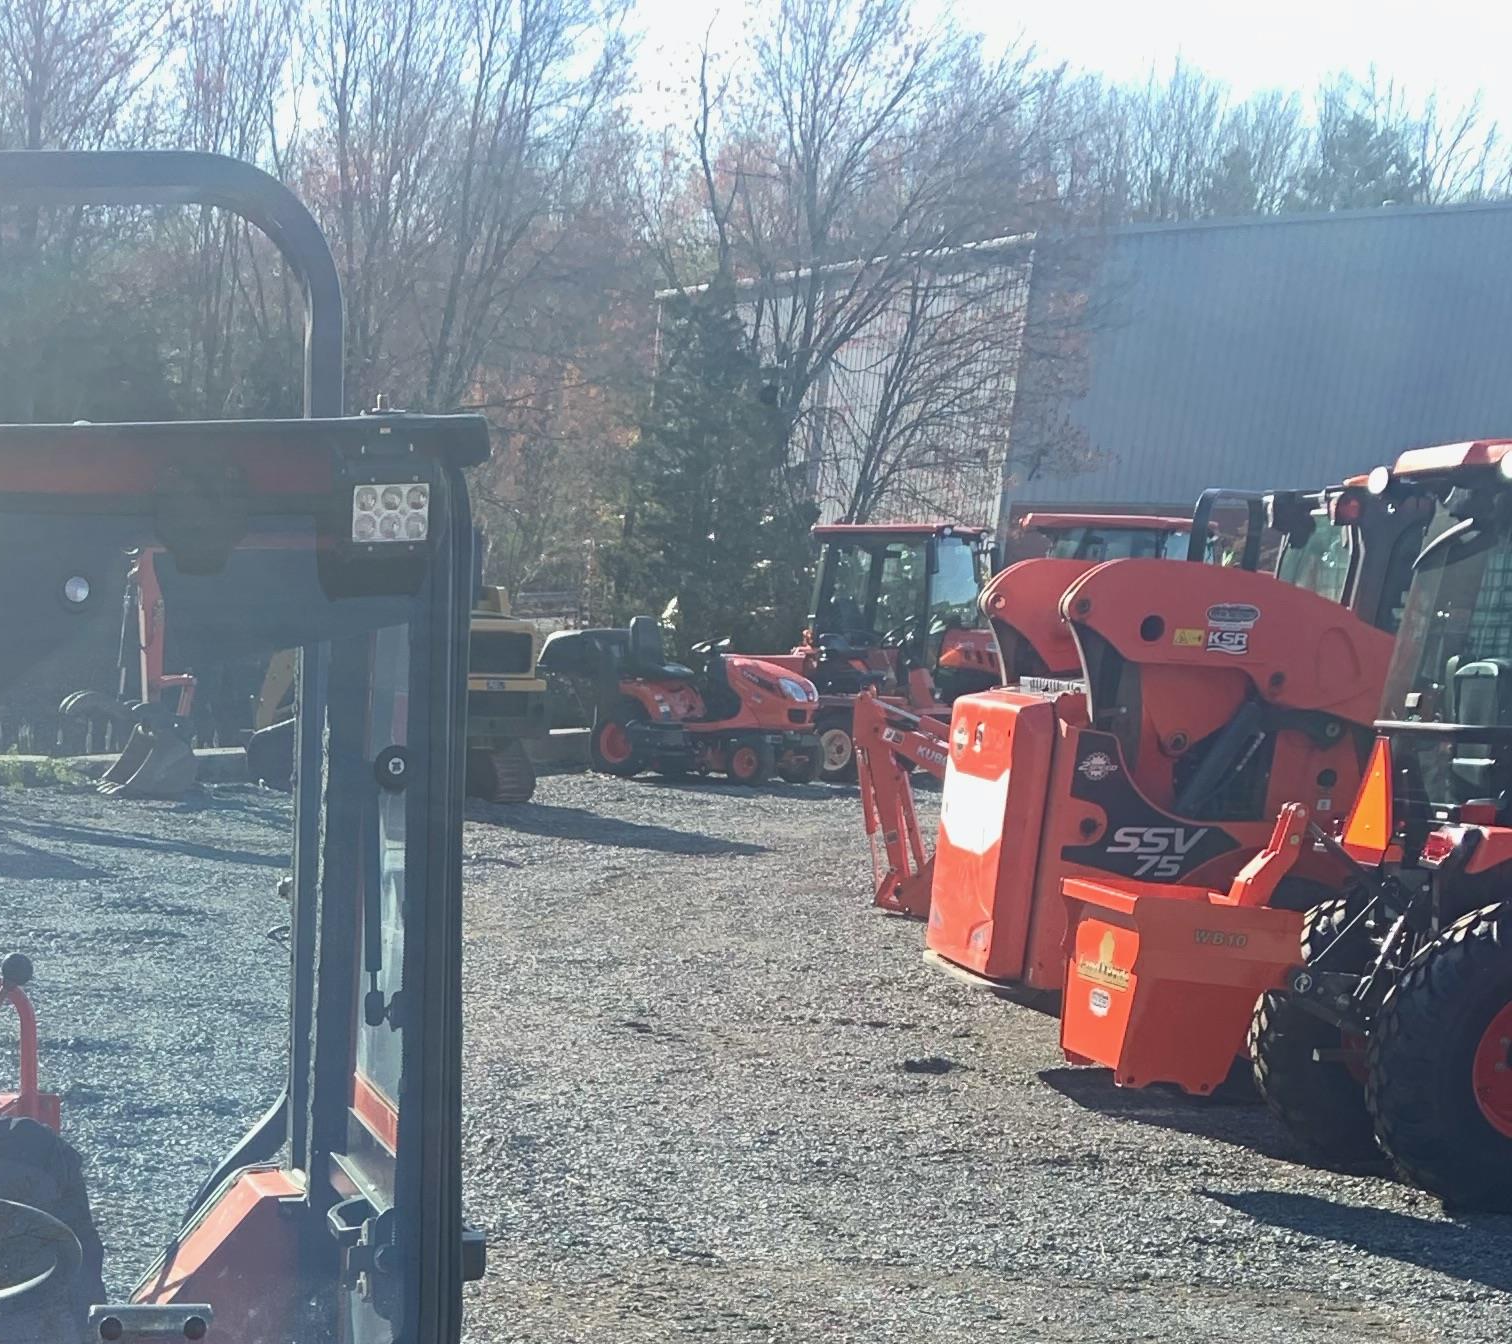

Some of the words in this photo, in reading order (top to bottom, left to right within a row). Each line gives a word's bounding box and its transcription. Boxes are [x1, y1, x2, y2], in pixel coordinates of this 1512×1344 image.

[1208, 631, 1248, 645] KSR
[1105, 826, 1209, 853] SSV
[1133, 855, 1184, 877] 75
